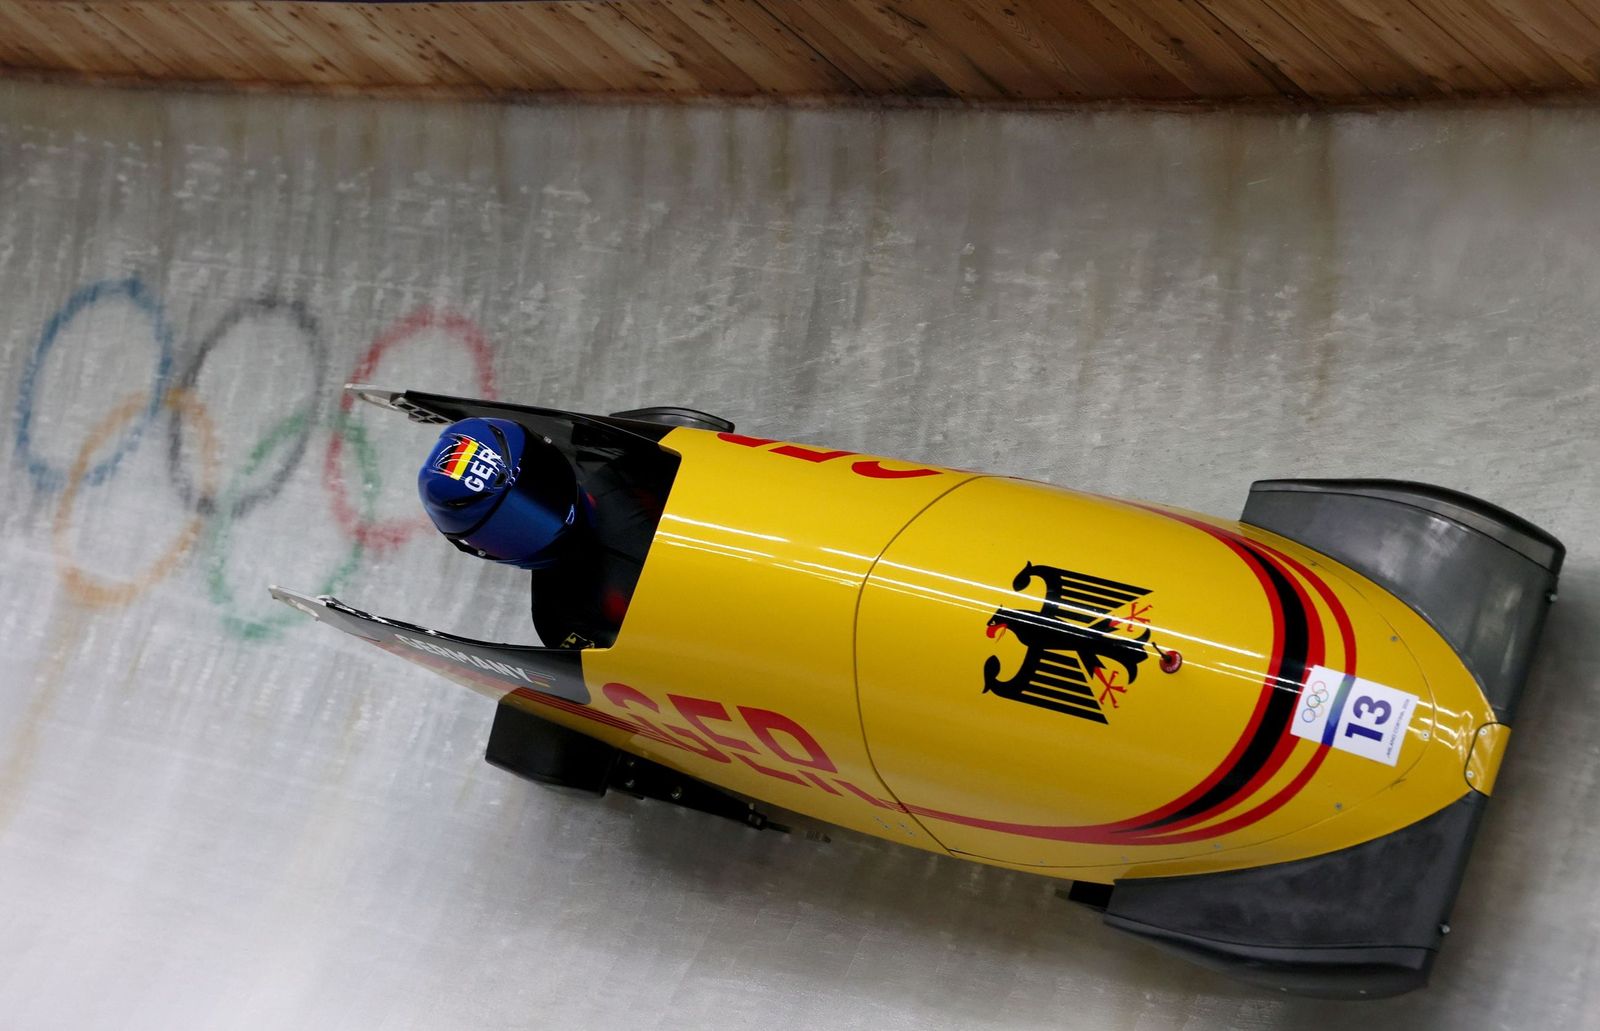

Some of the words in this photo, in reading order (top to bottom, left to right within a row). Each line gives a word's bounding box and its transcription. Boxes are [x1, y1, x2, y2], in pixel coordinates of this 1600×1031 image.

[464, 449, 502, 492] GER
[394, 633, 534, 683] GERMANY
[1345, 695, 1392, 742] 13
